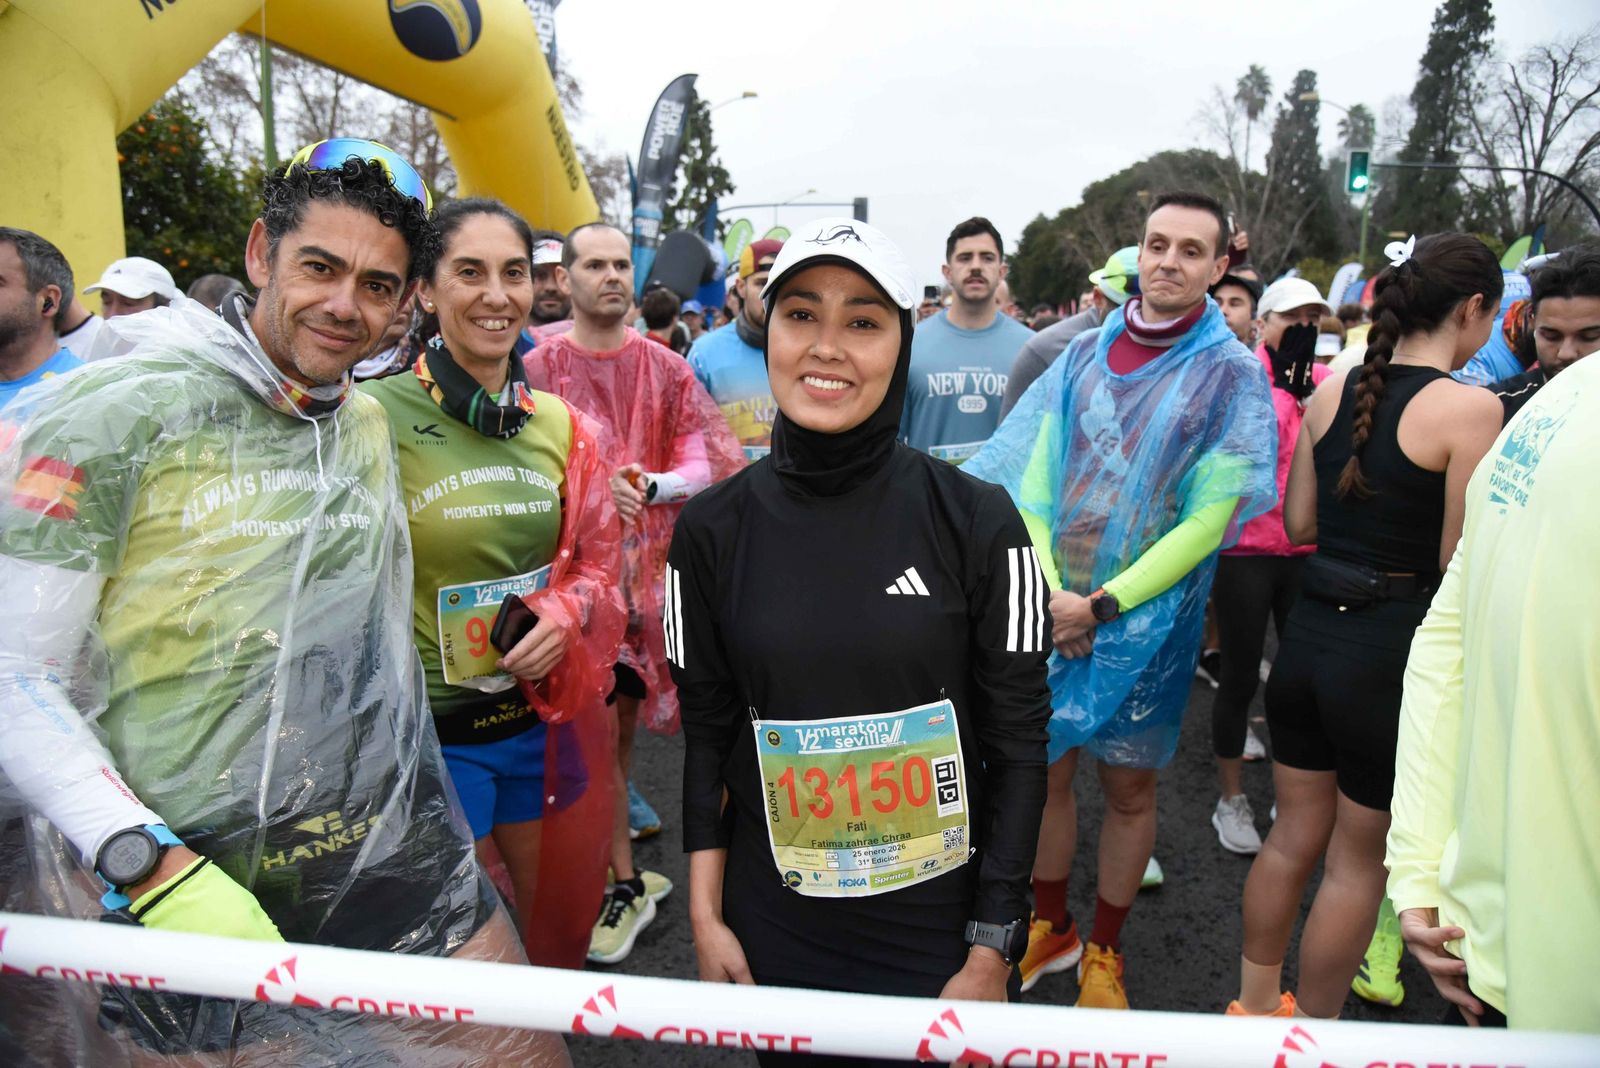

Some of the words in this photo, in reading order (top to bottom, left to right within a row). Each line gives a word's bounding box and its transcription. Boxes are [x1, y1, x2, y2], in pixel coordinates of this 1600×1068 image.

[647, 99, 673, 160] POWER
[926, 372, 967, 397] NEW
[970, 372, 1009, 396] YOR
[411, 474, 460, 516] ALWAYS
[461, 465, 517, 488] RUNNING
[517, 467, 560, 498] TOGETH
[181, 473, 257, 532] ALWAYS
[261, 469, 332, 493] RUNNIN
[443, 503, 502, 520] MOMENTS
[503, 502, 528, 516] NON
[529, 500, 553, 514] STOP
[339, 513, 371, 530] STOP
[491, 577, 535, 593] marat
[465, 616, 499, 659] 9
[814, 720, 889, 738] maratón
[835, 732, 890, 749] sevilla
[778, 756, 932, 819] 13150
[768, 791, 780, 823] CAJÓN
[846, 820, 868, 833] Fati
[811, 839, 843, 849] Fatima
[845, 837, 879, 848] zahrae
[881, 831, 912, 844] Chraa
[852, 849, 862, 858] 25
[863, 848, 887, 857] enero
[888, 843, 907, 853] 2026
[838, 877, 868, 888] HOKA
[874, 870, 910, 884] Sprinter
